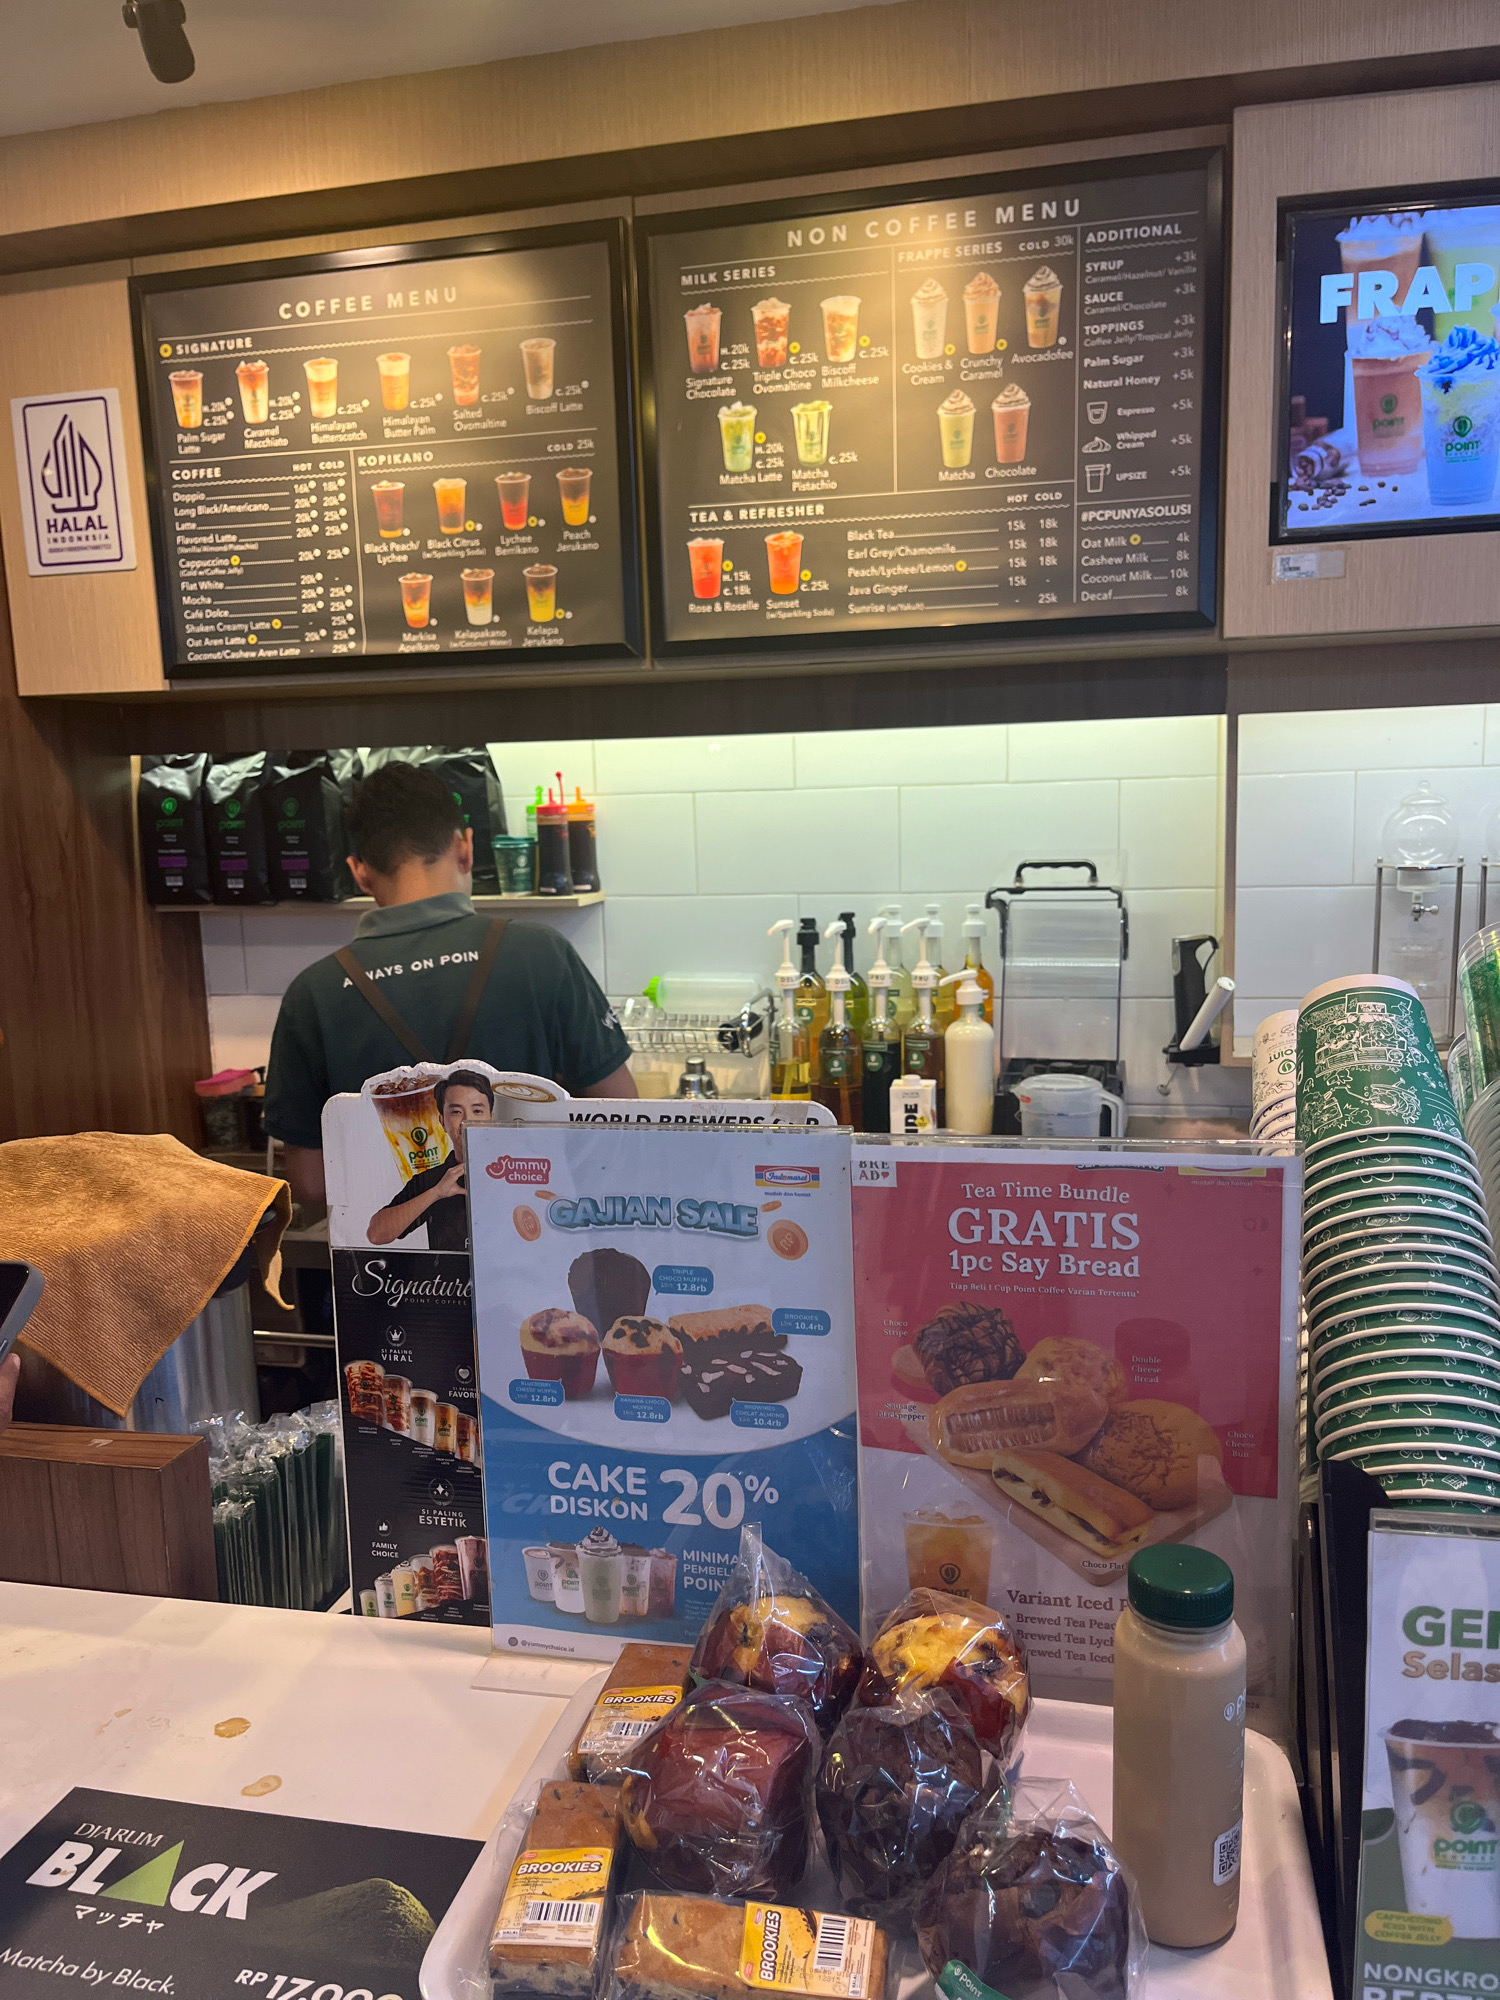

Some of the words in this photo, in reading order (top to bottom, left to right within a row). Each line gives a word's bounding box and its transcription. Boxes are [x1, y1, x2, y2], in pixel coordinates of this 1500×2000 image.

[788, 225, 847, 247] NON
[865, 211, 977, 238] COFFEE
[996, 199, 1079, 223] MENU
[1085, 224, 1182, 244] ADDITIONAL
[898, 247, 950, 263] FRAPPE
[955, 242, 1002, 257] SERIES
[1019, 241, 1049, 251] COLD
[1054, 236, 1073, 247] 30k
[1085, 260, 1124, 272] SYRUP
[681, 272, 717, 285] MILK
[723, 266, 776, 281] SERIES
[1084, 292, 1123, 304] SAUCE
[1320, 263, 1495, 324] FRAP
[279, 295, 372, 319] COFFEE
[387, 287, 456, 308] MENU
[1084, 320, 1144, 335] TOPPINGS
[176, 338, 253, 355] SIGNATURE
[960, 357, 1003, 369] Crunchy
[1084, 358, 1110, 367] Palm
[1112, 355, 1144, 366] Sugar
[902, 364, 942, 374] Cookies
[960, 368, 1003, 381] Caramel
[911, 374, 944, 385] Cream
[1084, 378, 1122, 389] Natural
[1125, 376, 1160, 386] Honey
[358, 452, 433, 467] KOPIKANO
[172, 467, 221, 480] COFFEE
[939, 471, 975, 481] Matcha
[985, 466, 1037, 478] Chocolate
[1035, 492, 1062, 501] COLD
[690, 511, 718, 522] TEA
[723, 510, 733, 521] &
[739, 504, 824, 519] REFRESHER
[1081, 504, 1191, 522] #PCPUNYASOLUSI
[46, 515, 108, 534] HALAL
[47, 534, 109, 544] INDONESIA
[847, 531, 874, 541] Black
[876, 529, 894, 539] Tea
[1081, 539, 1101, 548] Oat
[1104, 536, 1127, 546] Milk
[848, 550, 867, 560] Earl
[1081, 555, 1123, 566] Cashew
[1126, 553, 1148, 563] Milk
[1081, 572, 1126, 584] Coconut
[1129, 570, 1152, 580] Milk
[1081, 589, 1112, 601] Decaf
[343, 964, 403, 988] AWAYS
[411, 958, 434, 971] ON
[440, 951, 479, 965] POIN
[499, 1159, 547, 1173] Yummy
[509, 1172, 545, 1181] choice.
[768, 1172, 807, 1180] Indomaret
[961, 1183, 996, 1198] Tea
[1001, 1181, 1052, 1198] Time
[1059, 1183, 1129, 1203] Bundle
[550, 1196, 671, 1228] GAJIAN
[677, 1199, 759, 1237] SALE
[948, 1207, 1140, 1250] GRATIS
[949, 1250, 992, 1277] 1pc
[1002, 1252, 1049, 1280] Say
[1059, 1254, 1140, 1277] Bread
[352, 1260, 473, 1307] Signature
[677, 1283, 706, 1292] 12.8rb
[950, 1282, 967, 1291] Tiap
[994, 1285, 1011, 1293] Cup
[1014, 1285, 1035, 1293] Point
[1039, 1286, 1065, 1294] Coffee
[1068, 1287, 1095, 1296] Varian
[795, 1322, 823, 1330] 10.4rb
[883, 1328, 908, 1336] Stripe
[382, 1354, 412, 1362] VIRAL
[1132, 1356, 1161, 1364] Double
[531, 1395, 557, 1403] 12.8rb
[886, 1402, 917, 1412] Sausage
[637, 1412, 663, 1420] 12.8rb
[754, 1418, 781, 1426] 10.4rb
[878, 1410, 925, 1421] Blackpepper
[548, 1461, 647, 1495] CAKE
[550, 1495, 648, 1521] DISKON
[660, 1469, 779, 1529] 20%
[419, 1516, 467, 1528] ESTETIK
[372, 1550, 399, 1558] CHOICE
[683, 1550, 739, 1564] MINIMA
[683, 1576, 725, 1592] POIN
[1007, 1590, 1071, 1608] Variant
[1077, 1596, 1114, 1611] Iced
[1016, 1614, 1061, 1626] Brewed
[1064, 1617, 1085, 1628] Tea
[1016, 1630, 1061, 1642] Brewed
[1065, 1634, 1085, 1644] Tea
[1065, 1650, 1086, 1661] Tea
[1090, 1652, 1114, 1663] Iced
[604, 1695, 676, 1704] BROOKIES
[74, 1822, 163, 1847] DJARUM
[517, 1861, 602, 1874] BROOKIES
[74, 1905, 164, 1934] マッチャ
[760, 1910, 781, 1981] BROOKIES
[0, 1948, 79, 1977] Matcha
[81, 1961, 112, 1986] by
[113, 1968, 176, 1995] Black.
[1364, 1962, 1500, 1991] NONGKRO
[234, 1969, 268, 1986] RP
[266, 1975, 404, 2000] 17.0
